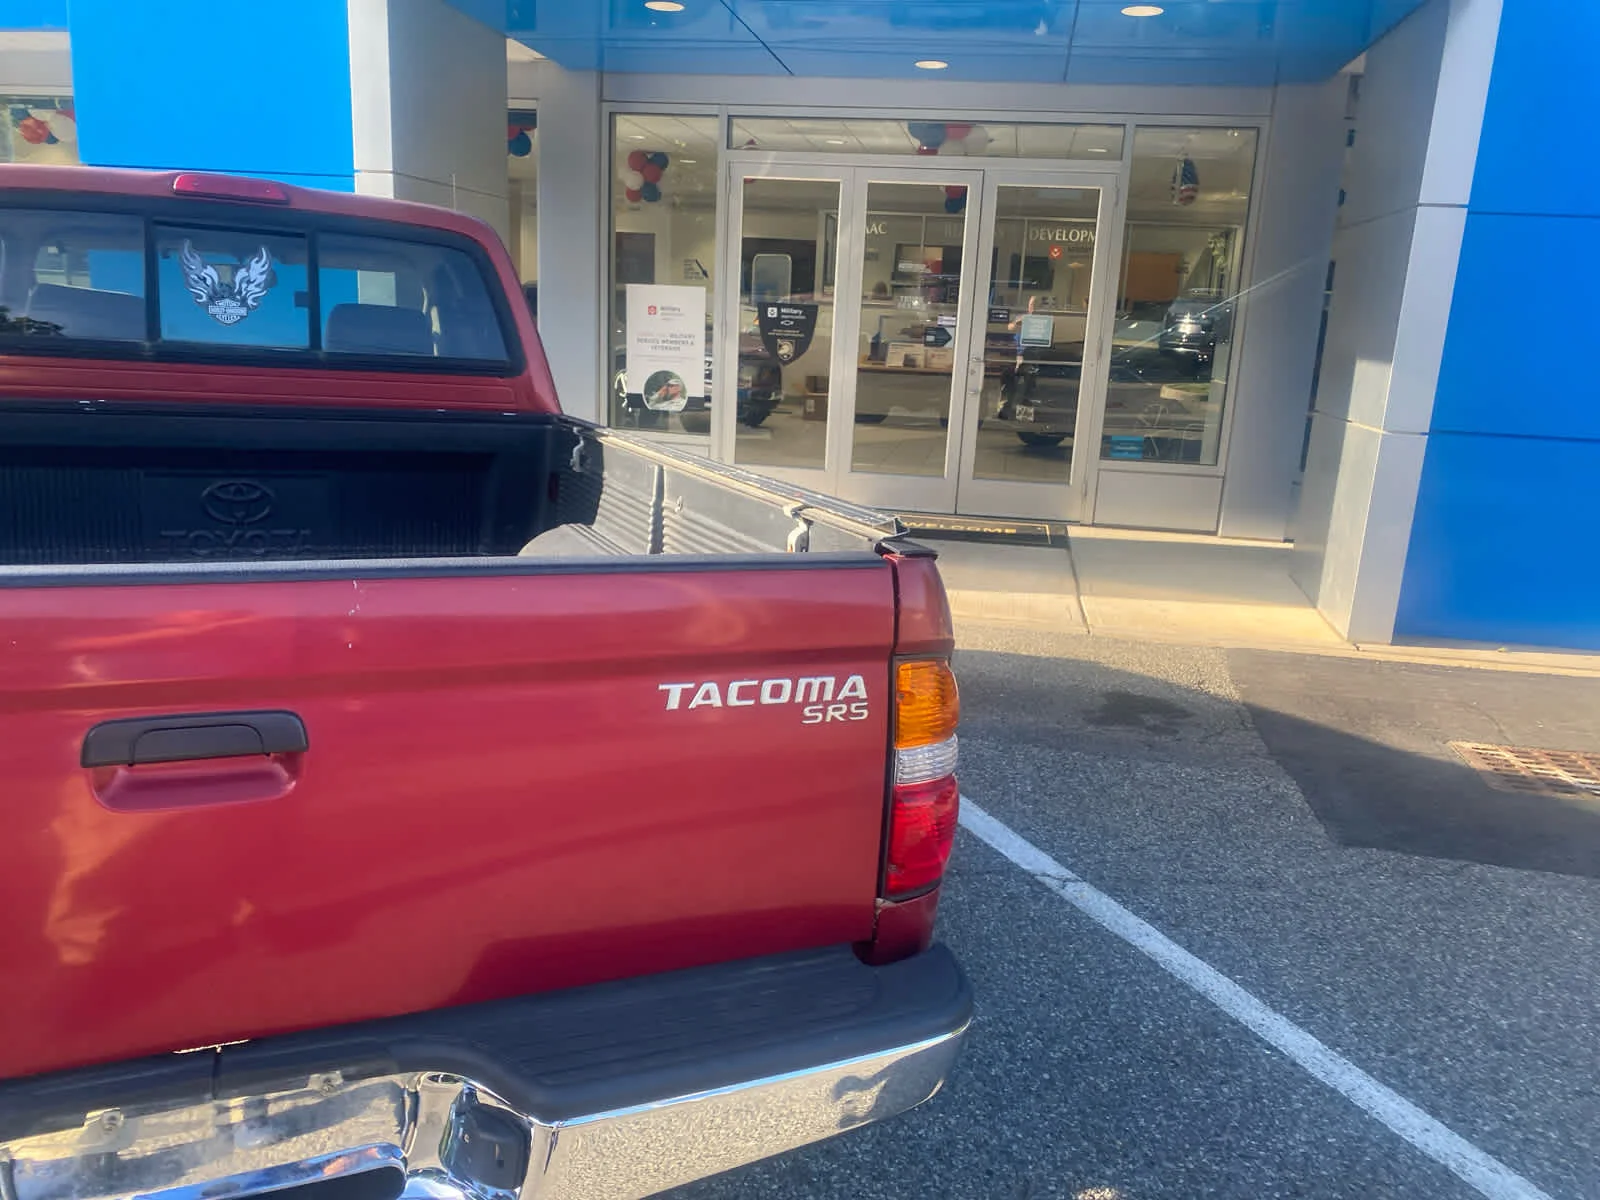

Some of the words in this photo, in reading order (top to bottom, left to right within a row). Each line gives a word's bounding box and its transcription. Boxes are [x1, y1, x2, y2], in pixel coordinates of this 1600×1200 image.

[903, 521, 1017, 534] WELCOME
[658, 675, 868, 711] TACOMA
[801, 702, 869, 724] SRS
